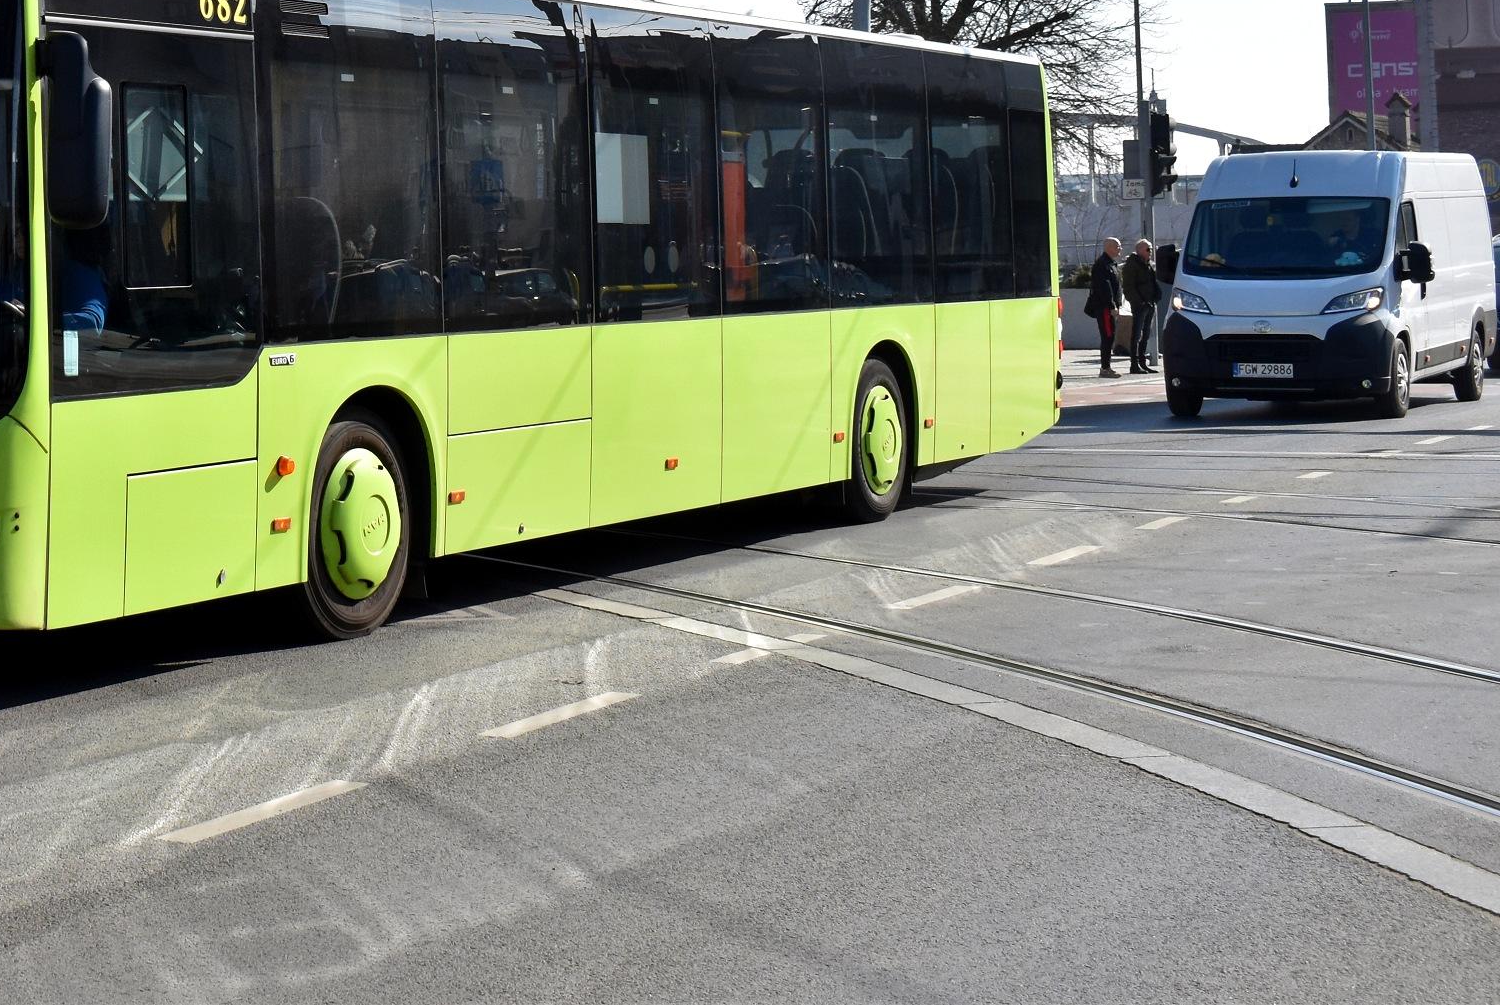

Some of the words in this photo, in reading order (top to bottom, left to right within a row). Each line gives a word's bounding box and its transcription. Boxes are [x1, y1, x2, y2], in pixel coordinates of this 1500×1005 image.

[271, 357, 287, 366] EURO
[289, 354, 295, 364] 6
[1238, 364, 1257, 375] FGW
[1261, 364, 1292, 375] 29886
